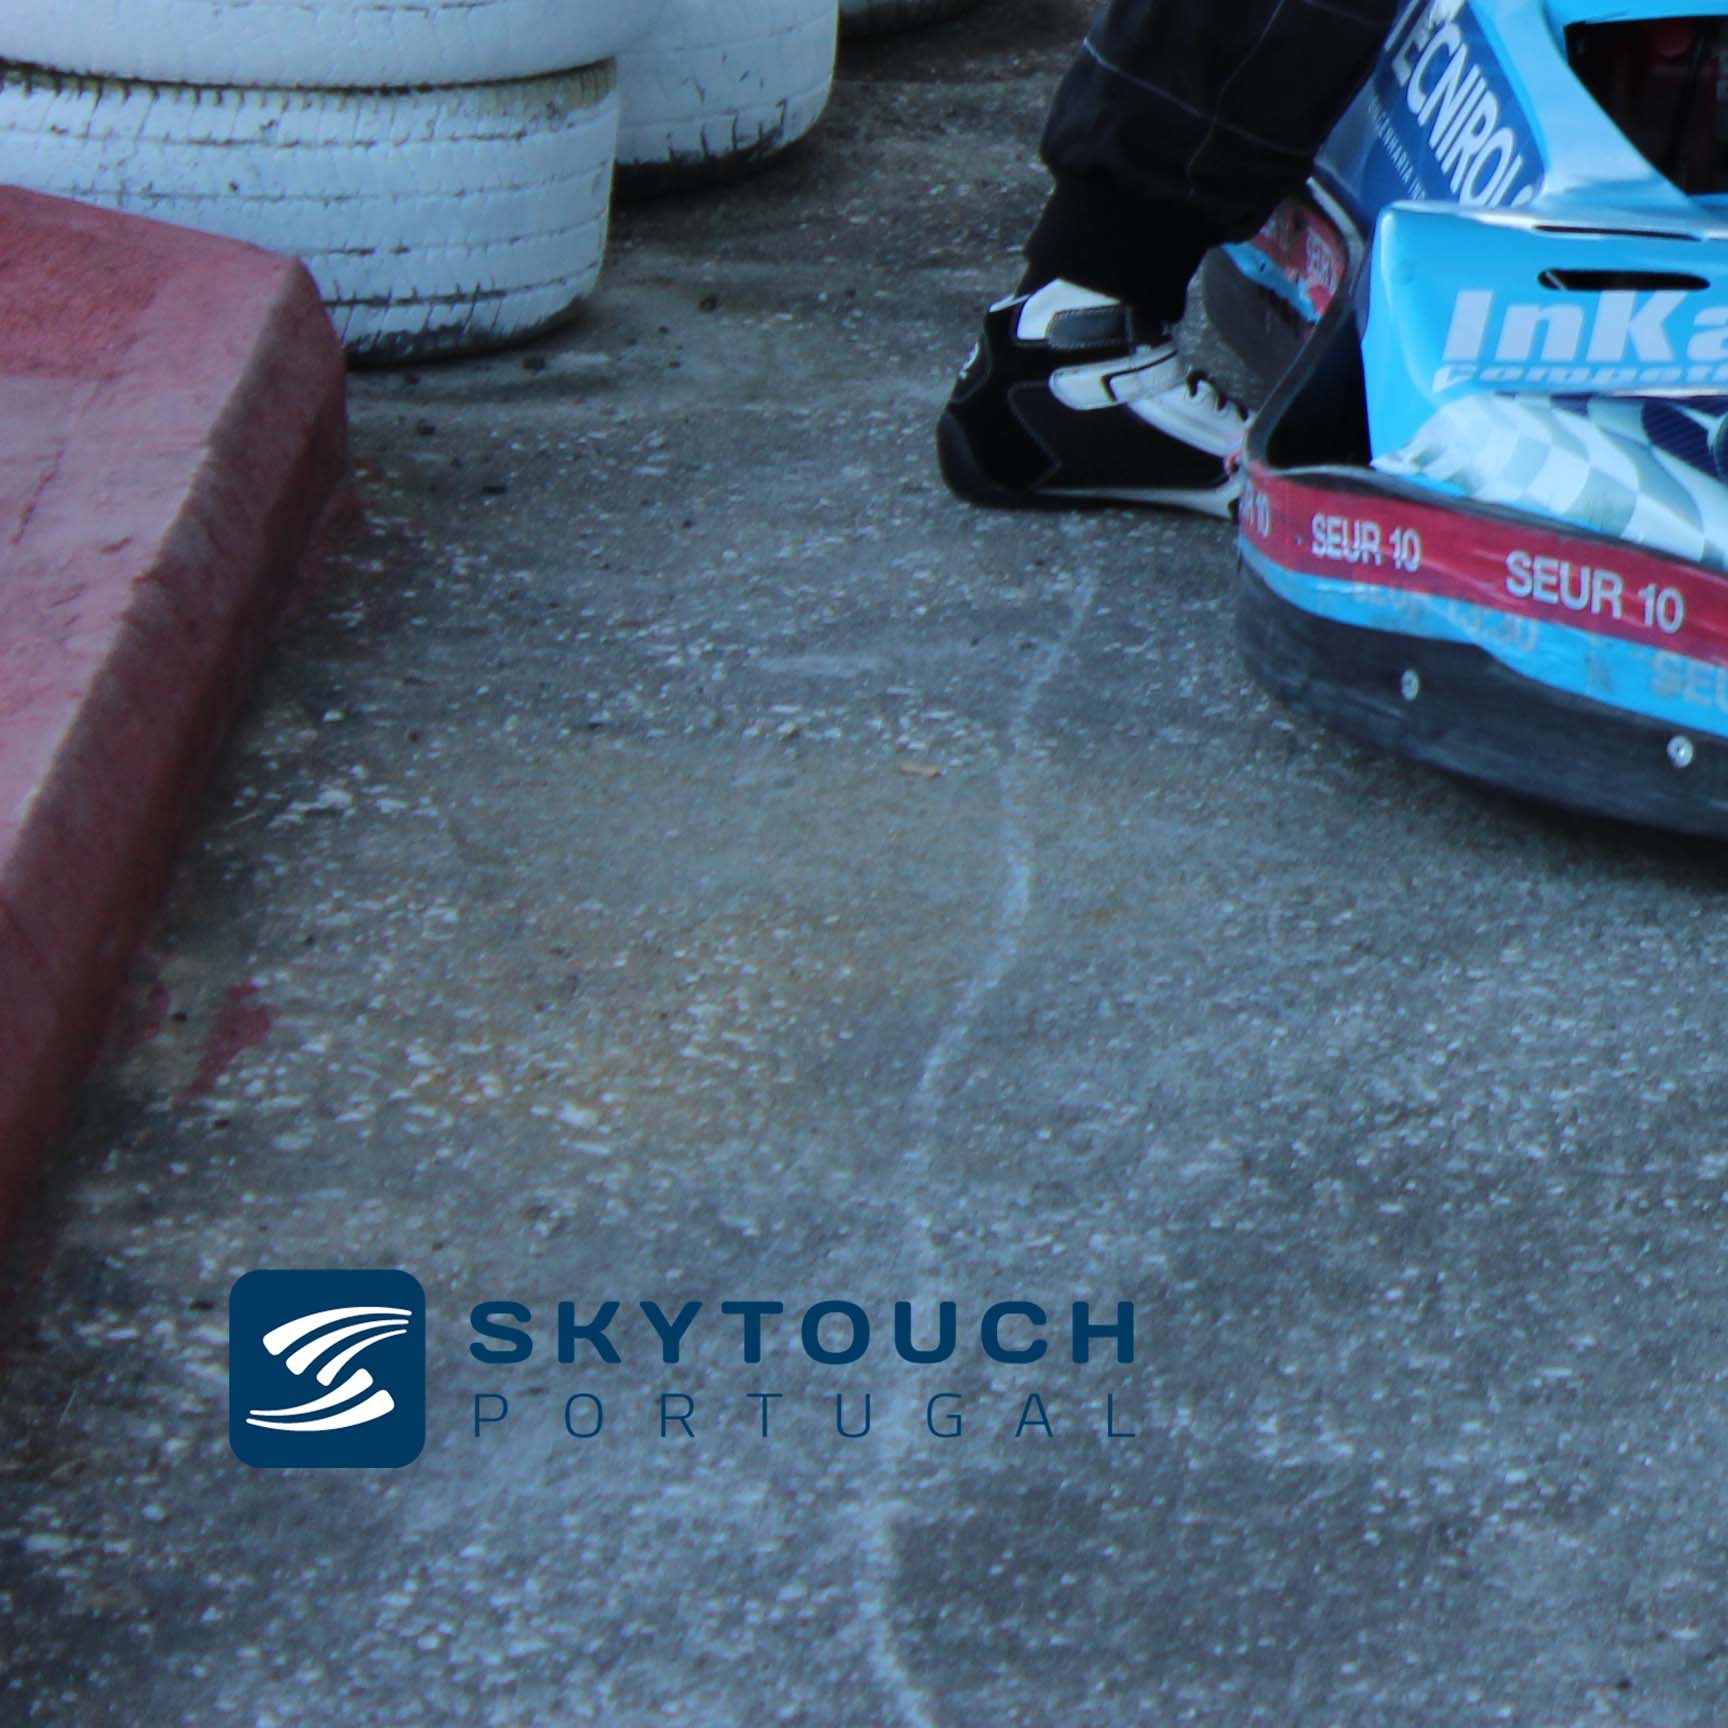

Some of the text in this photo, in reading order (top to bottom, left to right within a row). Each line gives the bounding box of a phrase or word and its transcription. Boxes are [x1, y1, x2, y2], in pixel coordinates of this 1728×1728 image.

[1312, 512, 1422, 572] SEUR 10
[1505, 550, 1685, 633] SEUR 10
